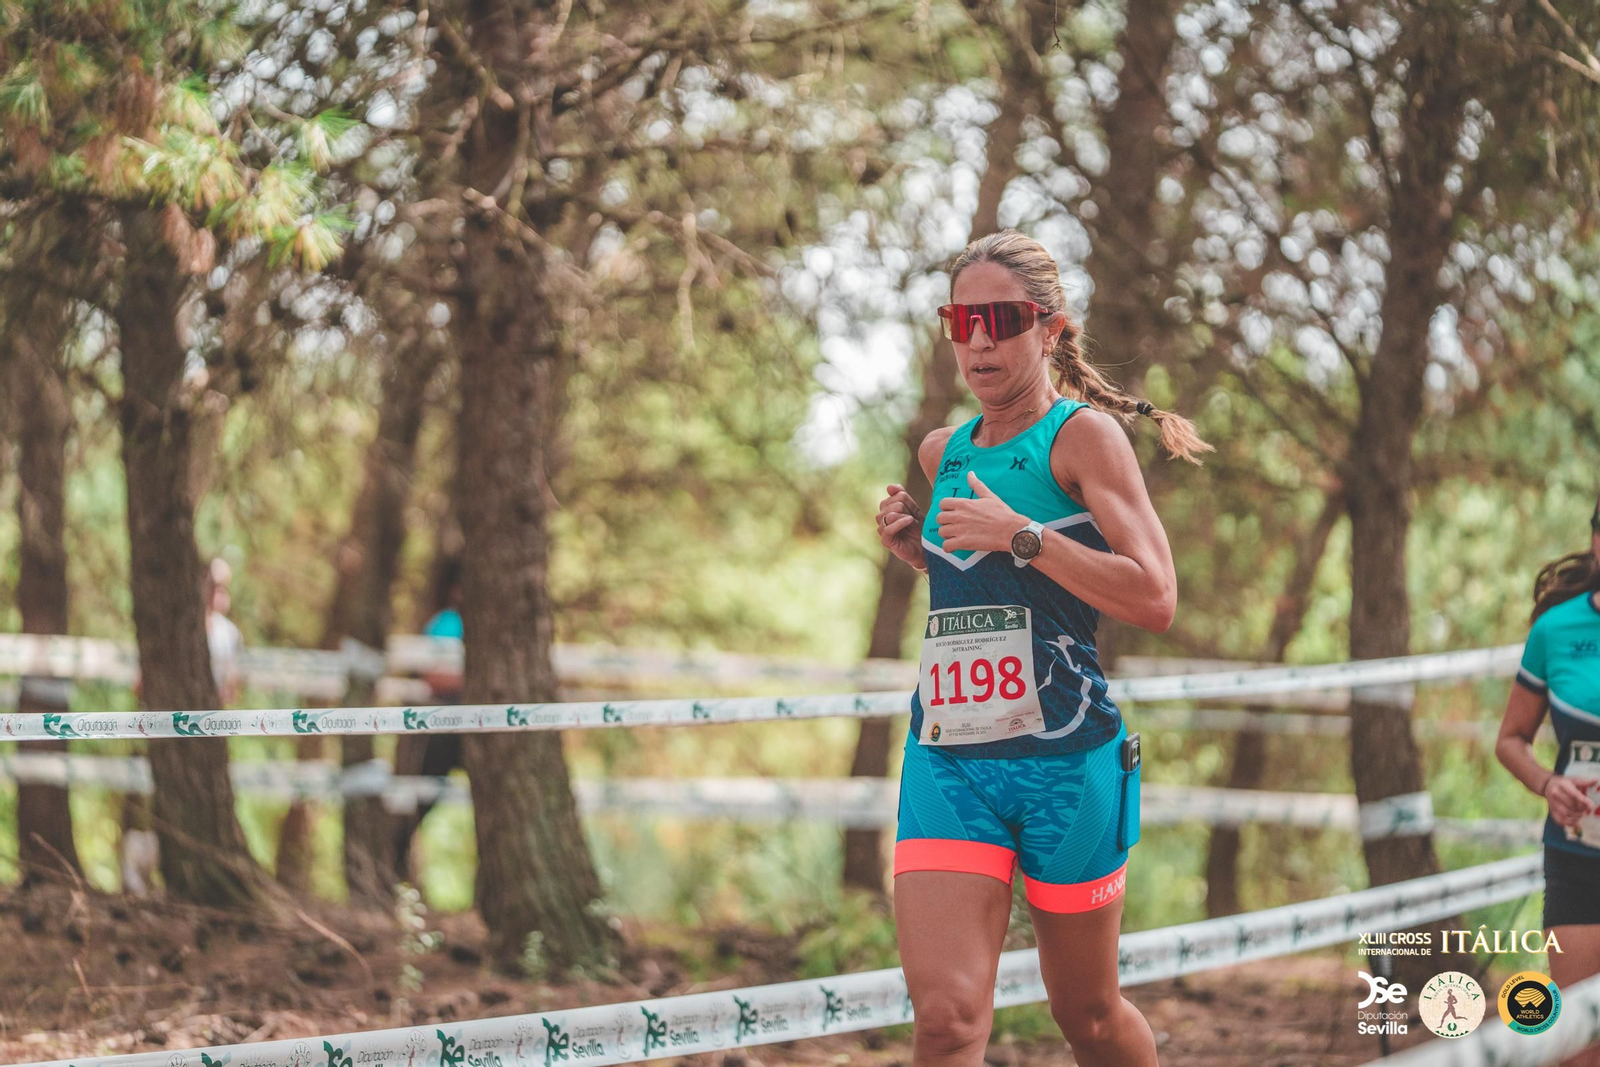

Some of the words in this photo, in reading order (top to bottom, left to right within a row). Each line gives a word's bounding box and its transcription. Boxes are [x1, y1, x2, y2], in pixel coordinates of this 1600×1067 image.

[942, 613, 995, 632] ITÁLICA
[974, 636, 1007, 644] RODRÍGUEZ
[930, 656, 1026, 706] 1198
[669, 1026, 699, 1046] Sevilla
[572, 1038, 604, 1059] Sevilla
[468, 1050, 501, 1067] Sevilla
